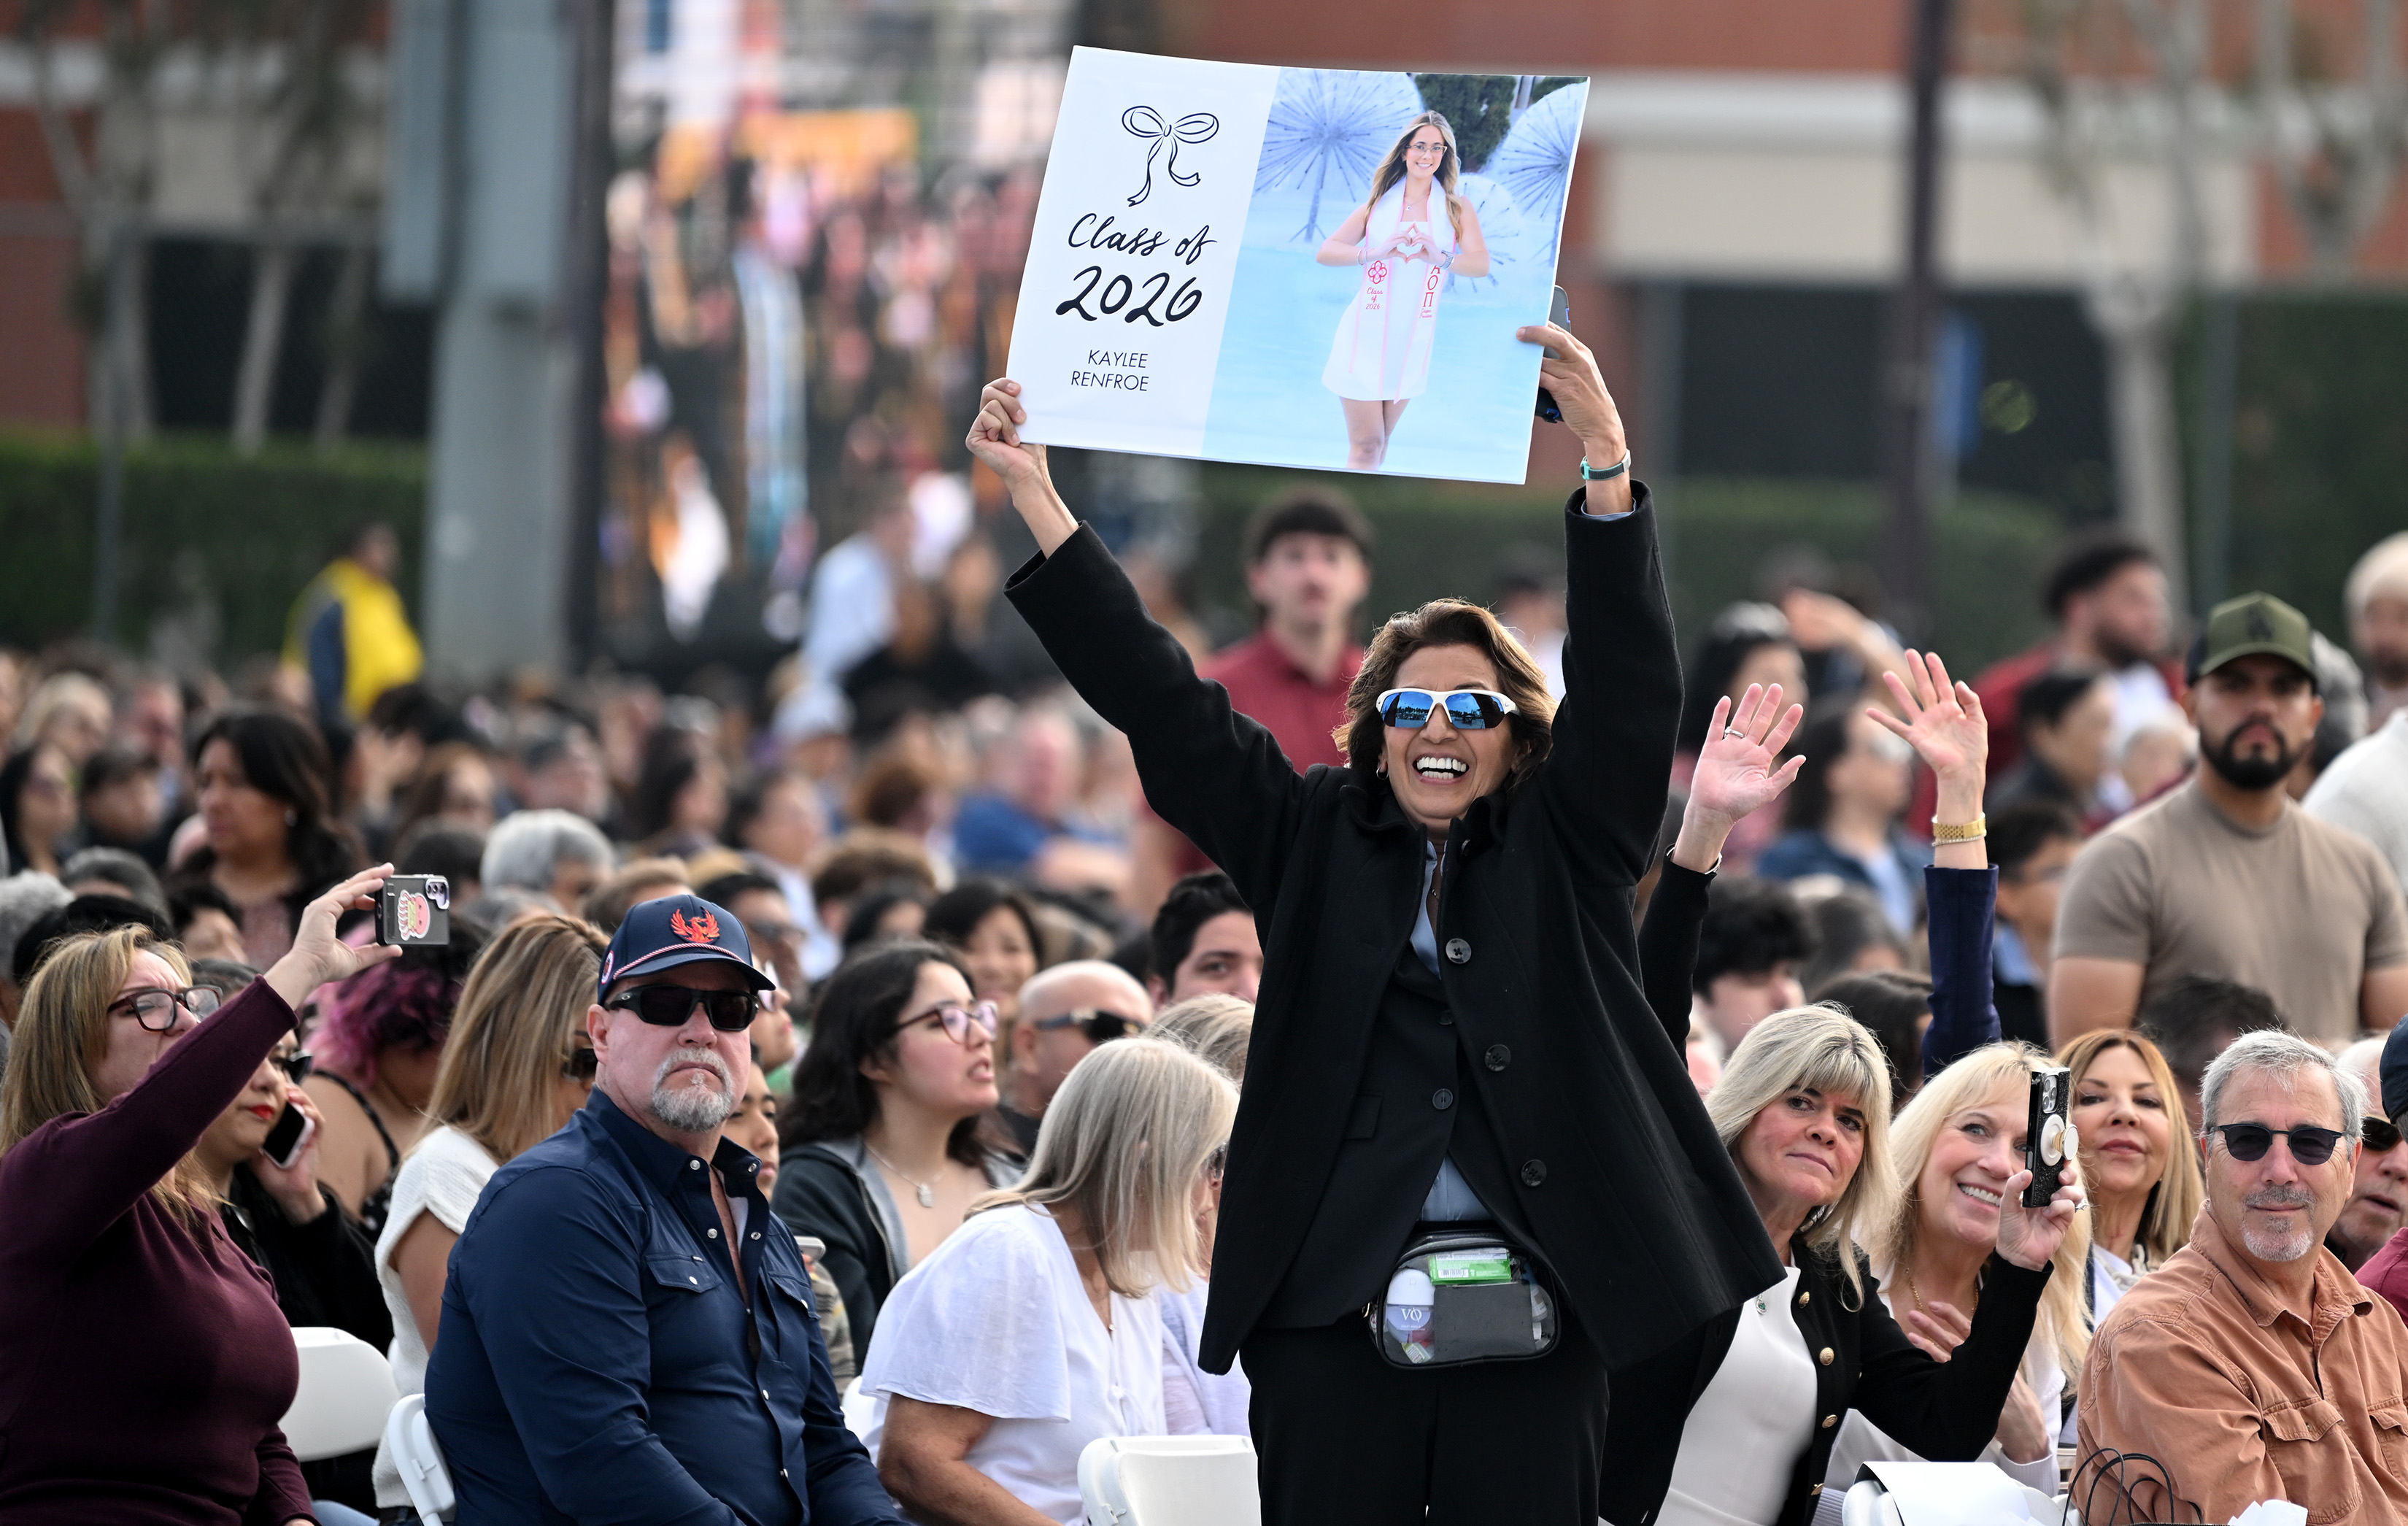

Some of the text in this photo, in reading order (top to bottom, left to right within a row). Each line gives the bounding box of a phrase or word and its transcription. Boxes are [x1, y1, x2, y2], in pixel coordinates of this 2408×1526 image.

[1068, 212, 1218, 266] Class of
[1055, 265, 1203, 327] 2026
[1367, 286, 1384, 295] Class
[1371, 295, 1378, 304] of
[1088, 350, 1149, 369] KAYLEE
[1071, 370, 1149, 392] RENFROE
